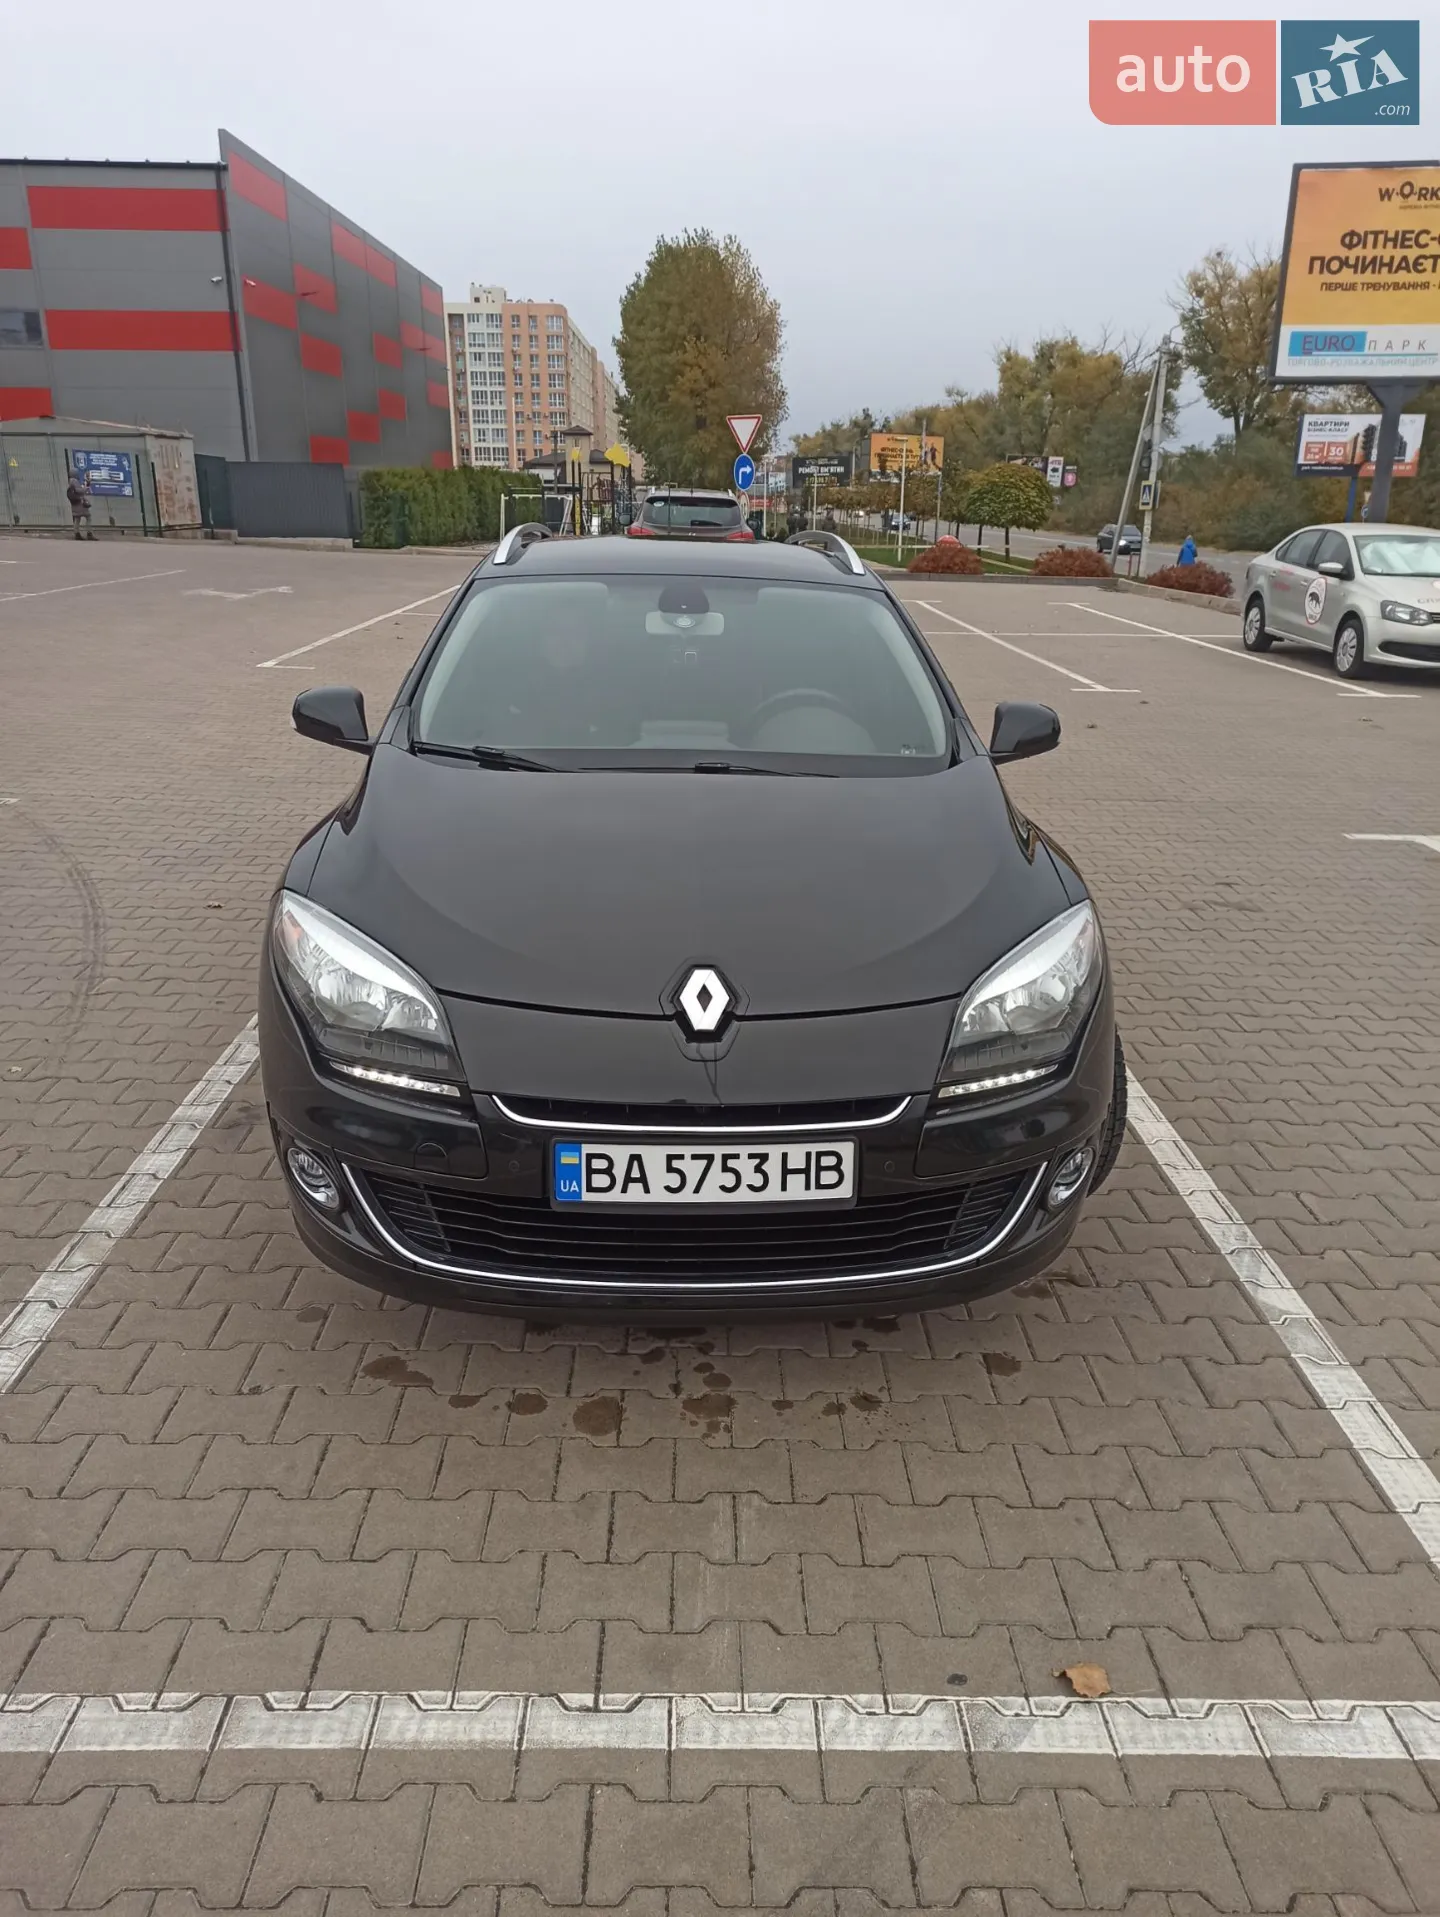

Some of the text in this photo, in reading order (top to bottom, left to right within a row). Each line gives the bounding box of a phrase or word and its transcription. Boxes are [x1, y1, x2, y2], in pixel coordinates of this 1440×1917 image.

[1340, 229, 1440, 250] ФІТНЕС-
[1320, 281, 1359, 292] ПЕРШЕ
[1361, 281, 1430, 291] ТРЕНУВАННЯ
[1302, 335, 1427, 352] EURO ПАРК
[1329, 446, 1344, 456] 30
[585, 1150, 845, 1194] BA 5753 HB
[560, 1180, 579, 1193] UA
